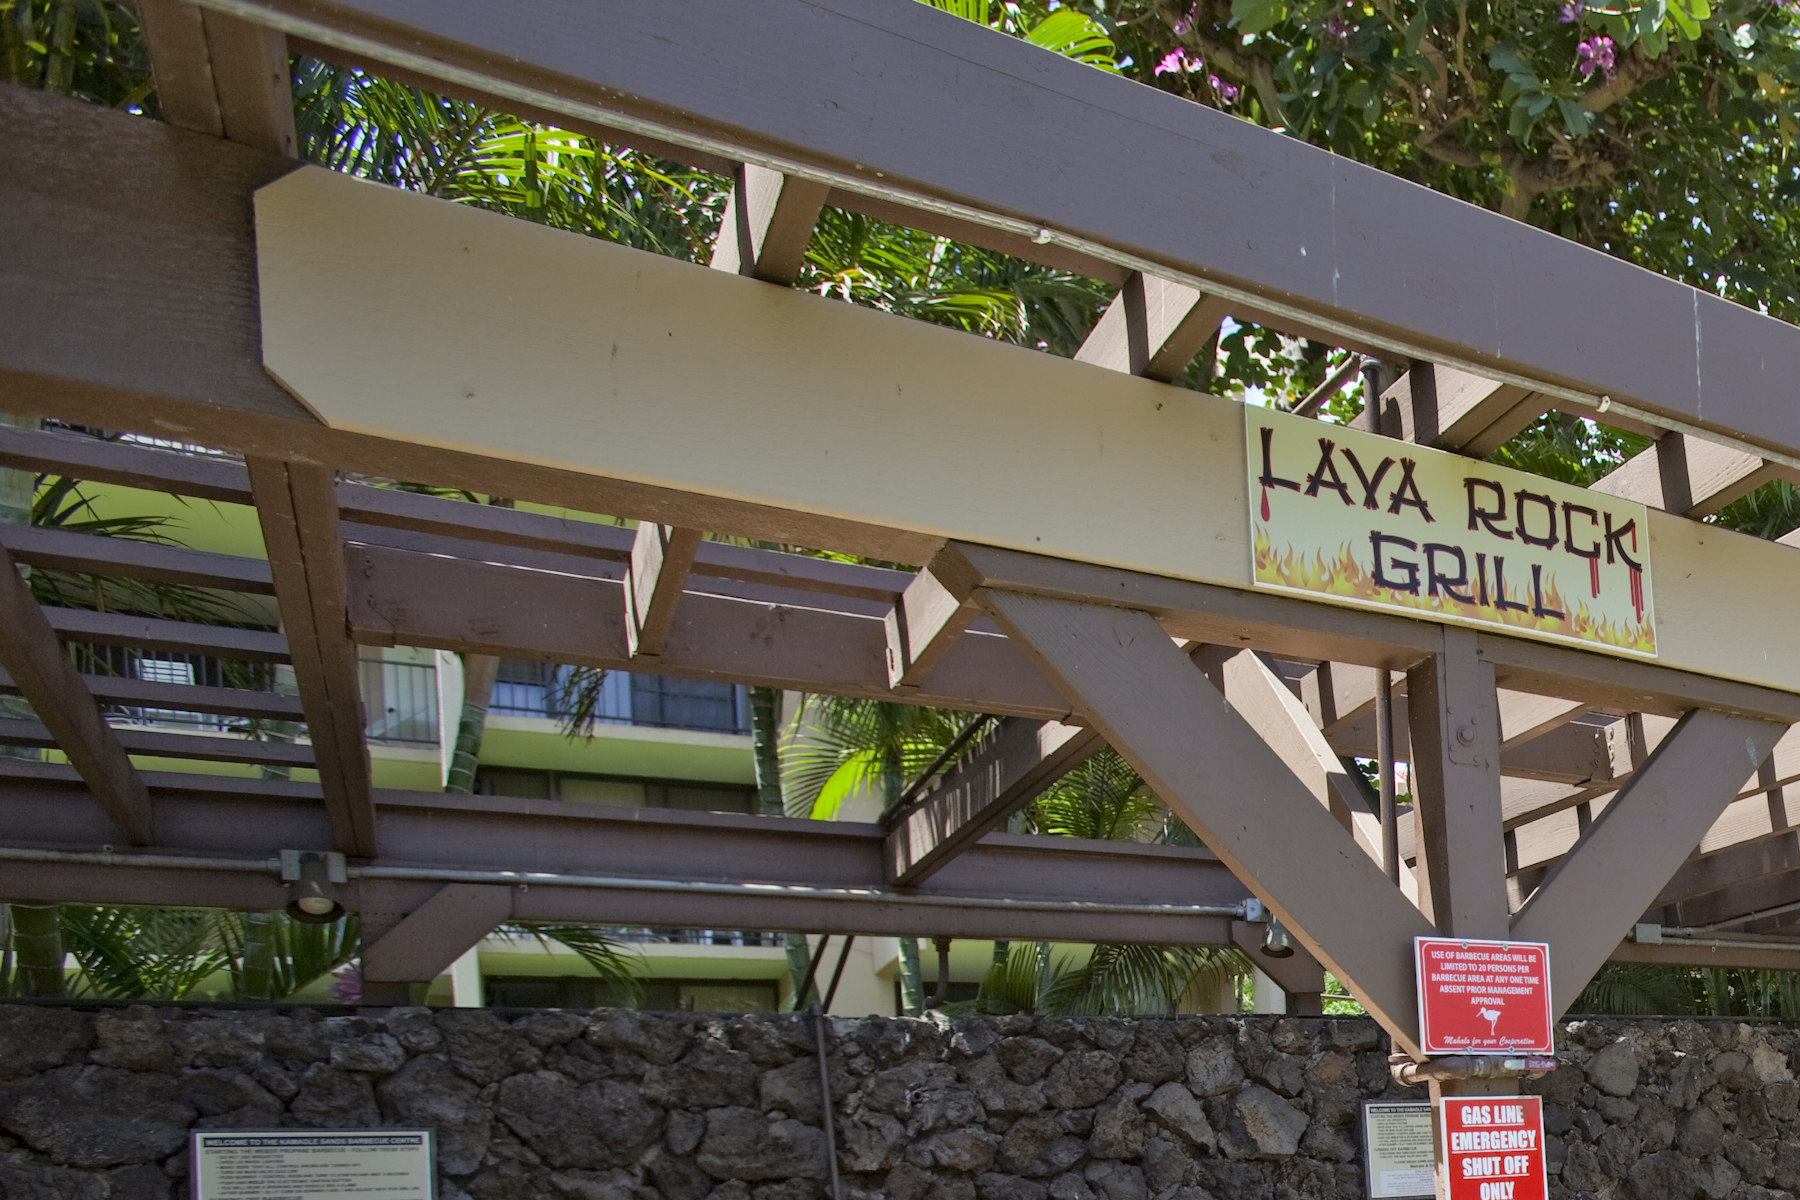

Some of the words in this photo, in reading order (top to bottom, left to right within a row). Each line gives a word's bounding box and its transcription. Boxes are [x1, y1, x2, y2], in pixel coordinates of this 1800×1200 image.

[1258, 426, 1437, 523] LAVA
[1463, 477, 1644, 573] ROCK
[1369, 530, 1566, 621] GRILL
[1431, 951, 1445, 959] USE
[1445, 951, 1455, 959] OF
[1456, 952, 1490, 961] BARBECUE
[1491, 953, 1512, 962] AREAS
[1512, 954, 1528, 962] WILL
[1528, 955, 1537, 963] BE
[1440, 962, 1468, 971] LIMITED
[1468, 963, 1478, 971] TO
[1478, 964, 1487, 972] 20
[1487, 964, 1517, 973] PERSONS
[1517, 965, 1530, 973] PER
[1431, 973, 1466, 982] BARBECUE
[1467, 974, 1485, 983] AREA
[1486, 975, 1494, 983] AT
[1495, 975, 1509, 983] ANY
[1509, 976, 1524, 984] ONE
[1523, 976, 1539, 984] TIME
[1440, 985, 1466, 993] ABSENT
[1466, 985, 1487, 994] PRIOR
[1487, 986, 1533, 995] MANAGEMENT
[1471, 996, 1505, 1005] APPROVAL
[1443, 1035, 1470, 1045] Mahalo
[1472, 1037, 1481, 1046] for
[1499, 1036, 1535, 1046] Cooperation
[1461, 1105, 1491, 1125] GAS
[1494, 1105, 1525, 1124] LINE
[1451, 1130, 1537, 1151] EMERGENCY
[1462, 1156, 1501, 1176] SHUT
[1504, 1155, 1529, 1174] OFF
